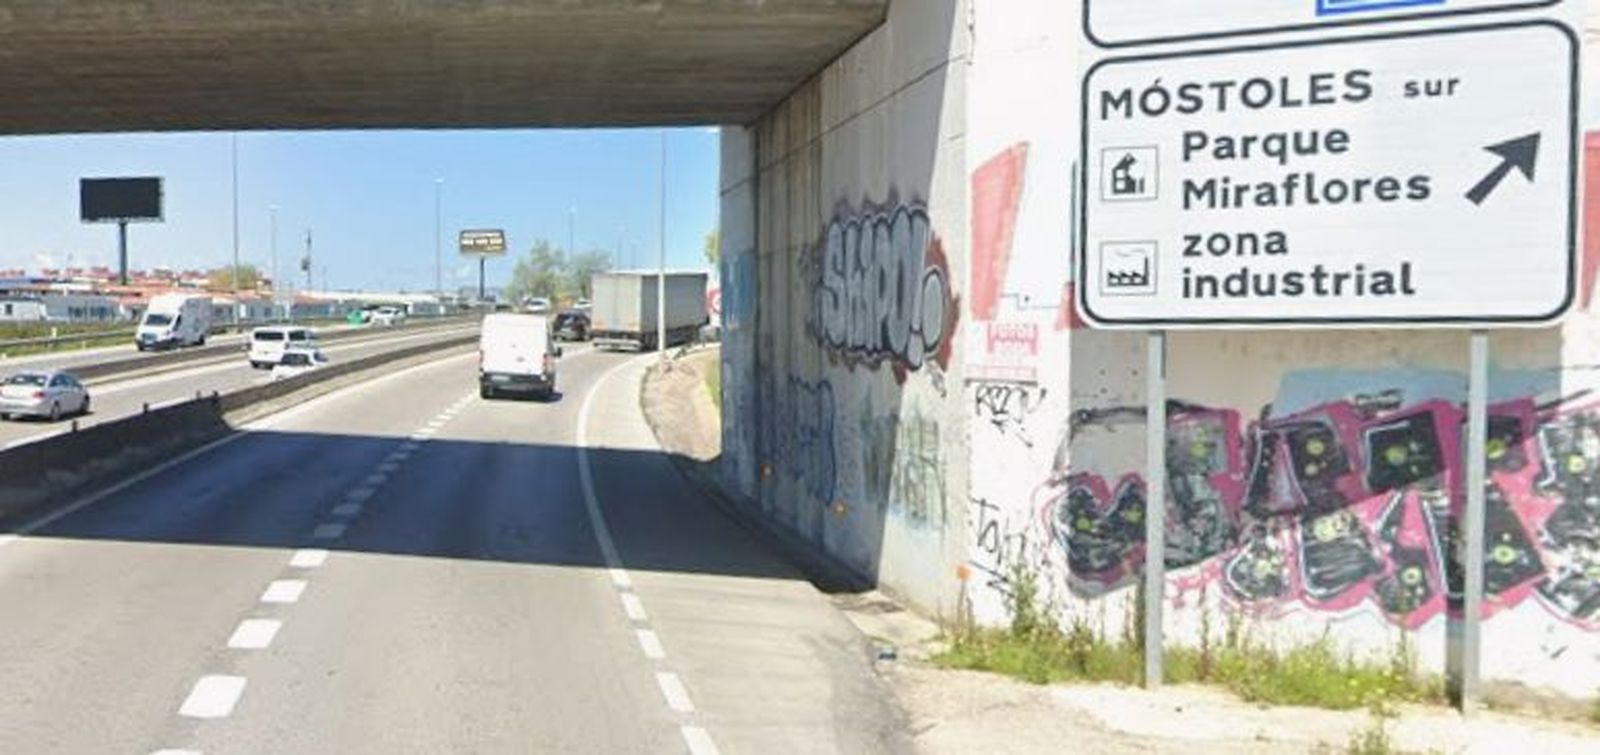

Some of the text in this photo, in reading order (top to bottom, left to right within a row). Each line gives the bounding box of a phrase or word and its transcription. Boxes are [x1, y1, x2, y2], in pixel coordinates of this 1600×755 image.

[1100, 69, 1460, 120] MÓSTOLES sur
[1183, 129, 1350, 165] Parque
[1182, 172, 1431, 211] Miraflores
[1182, 231, 1288, 257] zona
[1182, 262, 1416, 299] industrial
